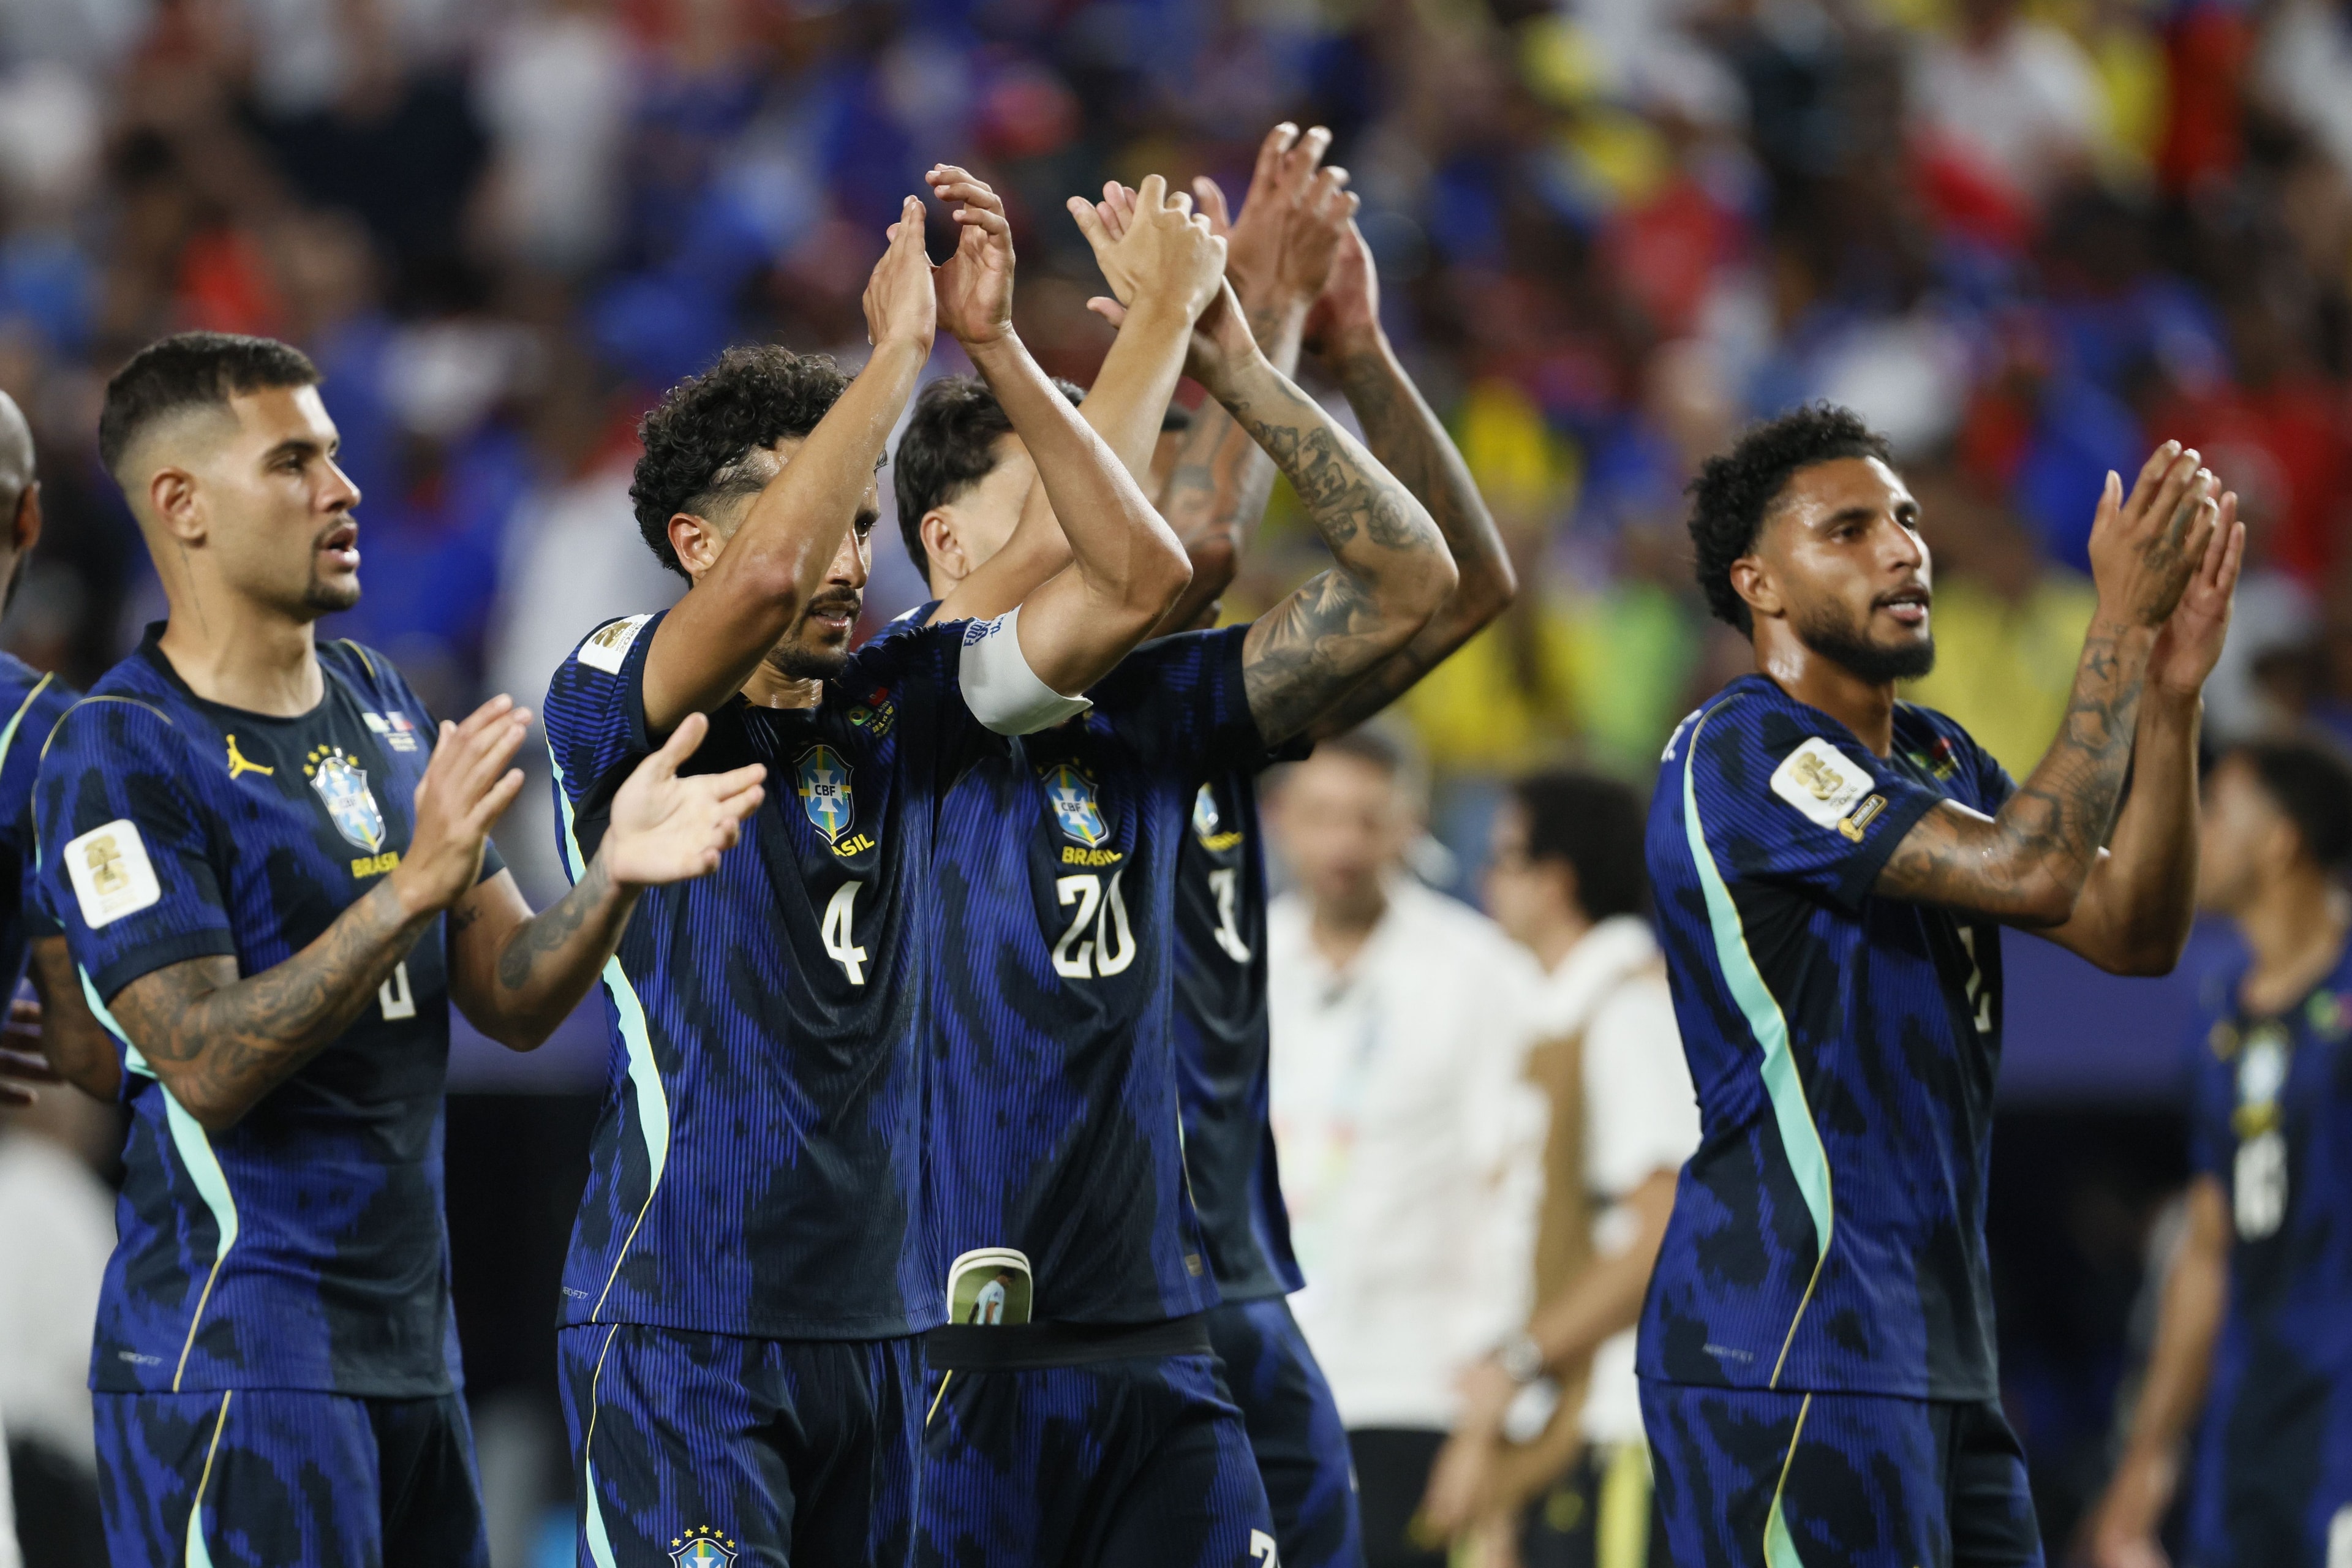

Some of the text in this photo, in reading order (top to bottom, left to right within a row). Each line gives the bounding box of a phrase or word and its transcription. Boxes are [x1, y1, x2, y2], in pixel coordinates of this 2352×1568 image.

[815, 784, 835, 796] CBF
[1061, 802, 1081, 813] CBF
[831, 833, 875, 857] ASIL
[1061, 846, 1123, 867] BRASIL
[821, 881, 868, 985] 4
[1052, 869, 1136, 979] 20
